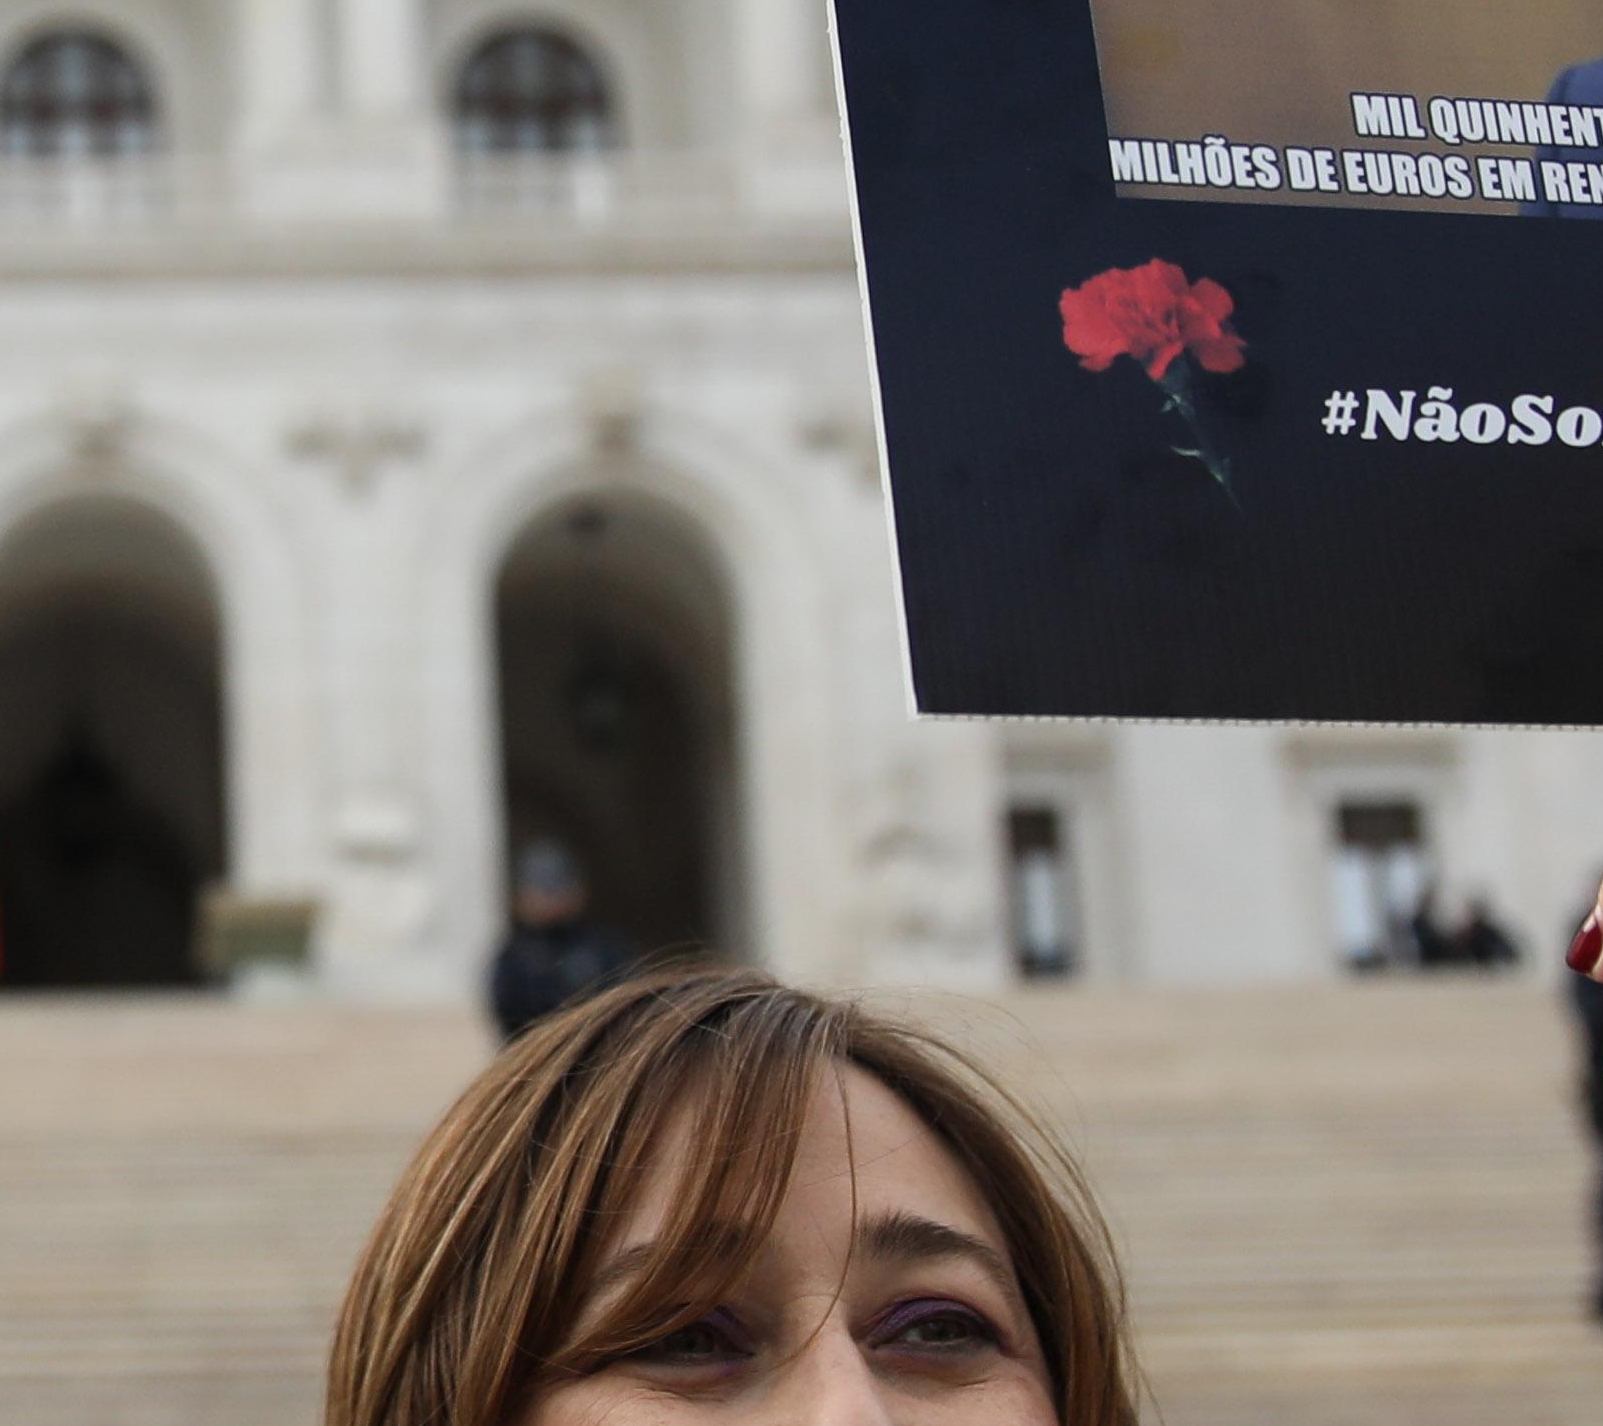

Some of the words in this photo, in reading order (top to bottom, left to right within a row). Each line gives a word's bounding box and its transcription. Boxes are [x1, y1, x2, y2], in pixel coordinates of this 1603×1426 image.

[1351, 94, 1426, 138] MIL
[1109, 135, 1281, 190] MILHÕES
[1285, 149, 1340, 192] DE
[1341, 151, 1473, 198] EUROS
[1477, 158, 1537, 201] EM
